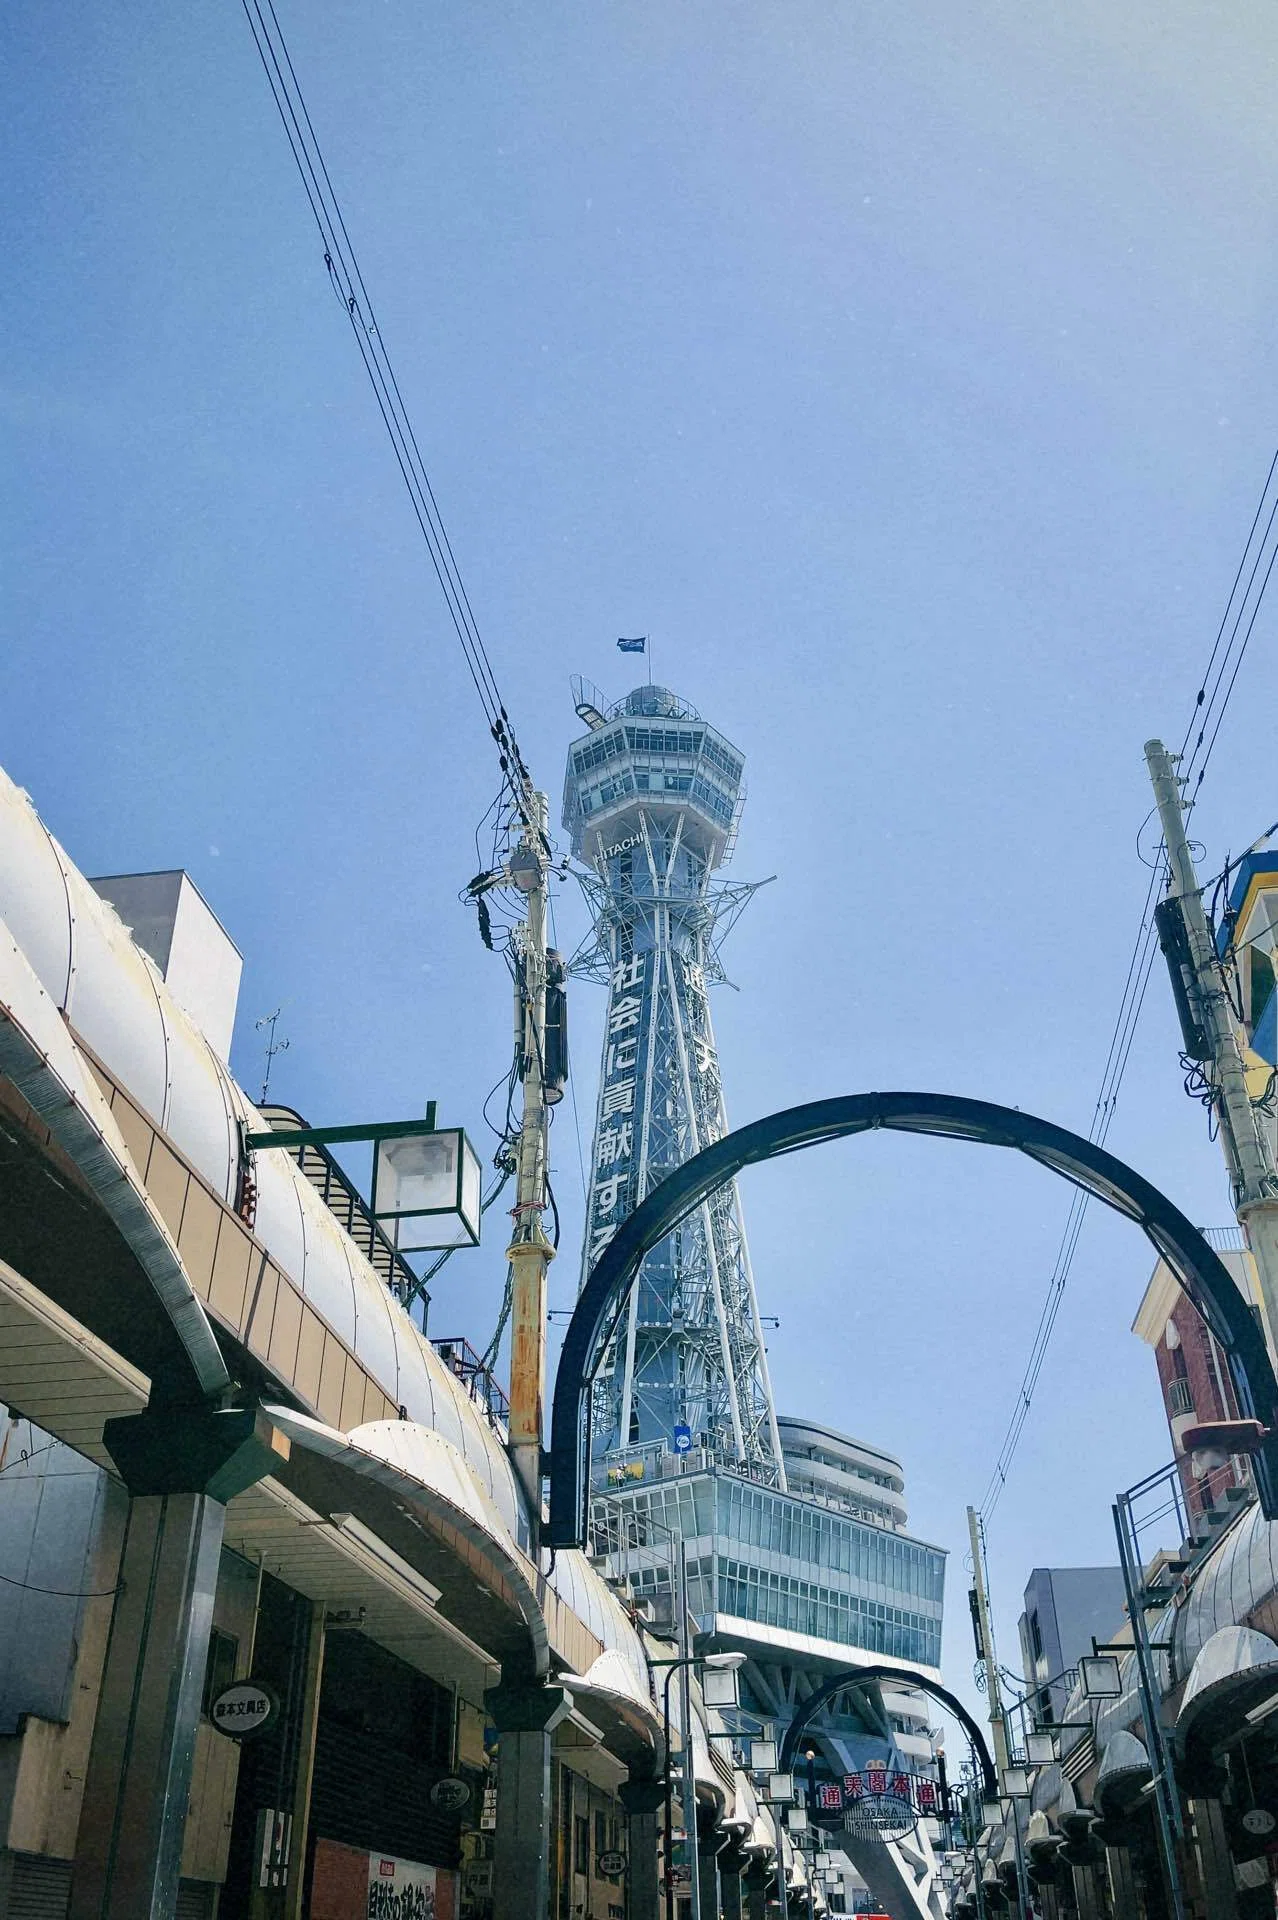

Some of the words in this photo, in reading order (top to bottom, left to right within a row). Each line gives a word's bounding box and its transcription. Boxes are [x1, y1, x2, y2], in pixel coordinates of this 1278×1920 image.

[593, 831, 644, 864] HITACHI
[862, 1807, 898, 1817] OSAKA
[855, 1820, 907, 1831] SHINSEKAI
